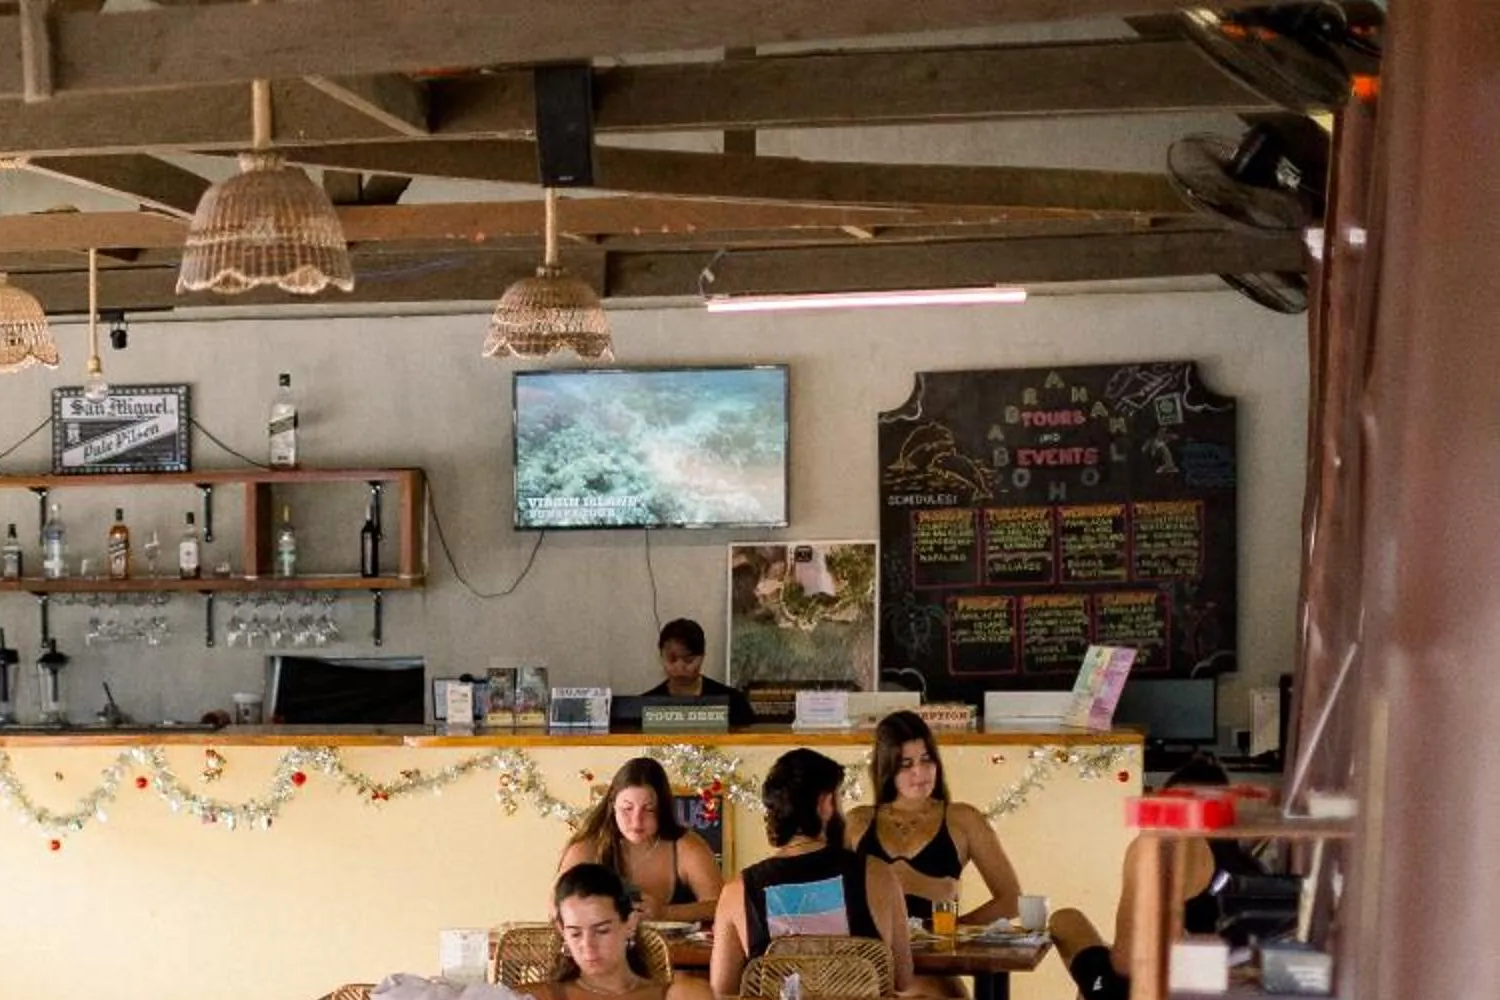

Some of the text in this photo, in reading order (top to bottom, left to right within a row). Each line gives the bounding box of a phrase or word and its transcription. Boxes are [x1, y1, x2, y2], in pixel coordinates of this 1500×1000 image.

[70, 397, 169, 418] San Miguel
[1021, 410, 1086, 427] TOURS
[83, 424, 160, 458] Pale Pilsen
[1017, 447, 1099, 466] EVENTS
[645, 711, 684, 721] TOUR
